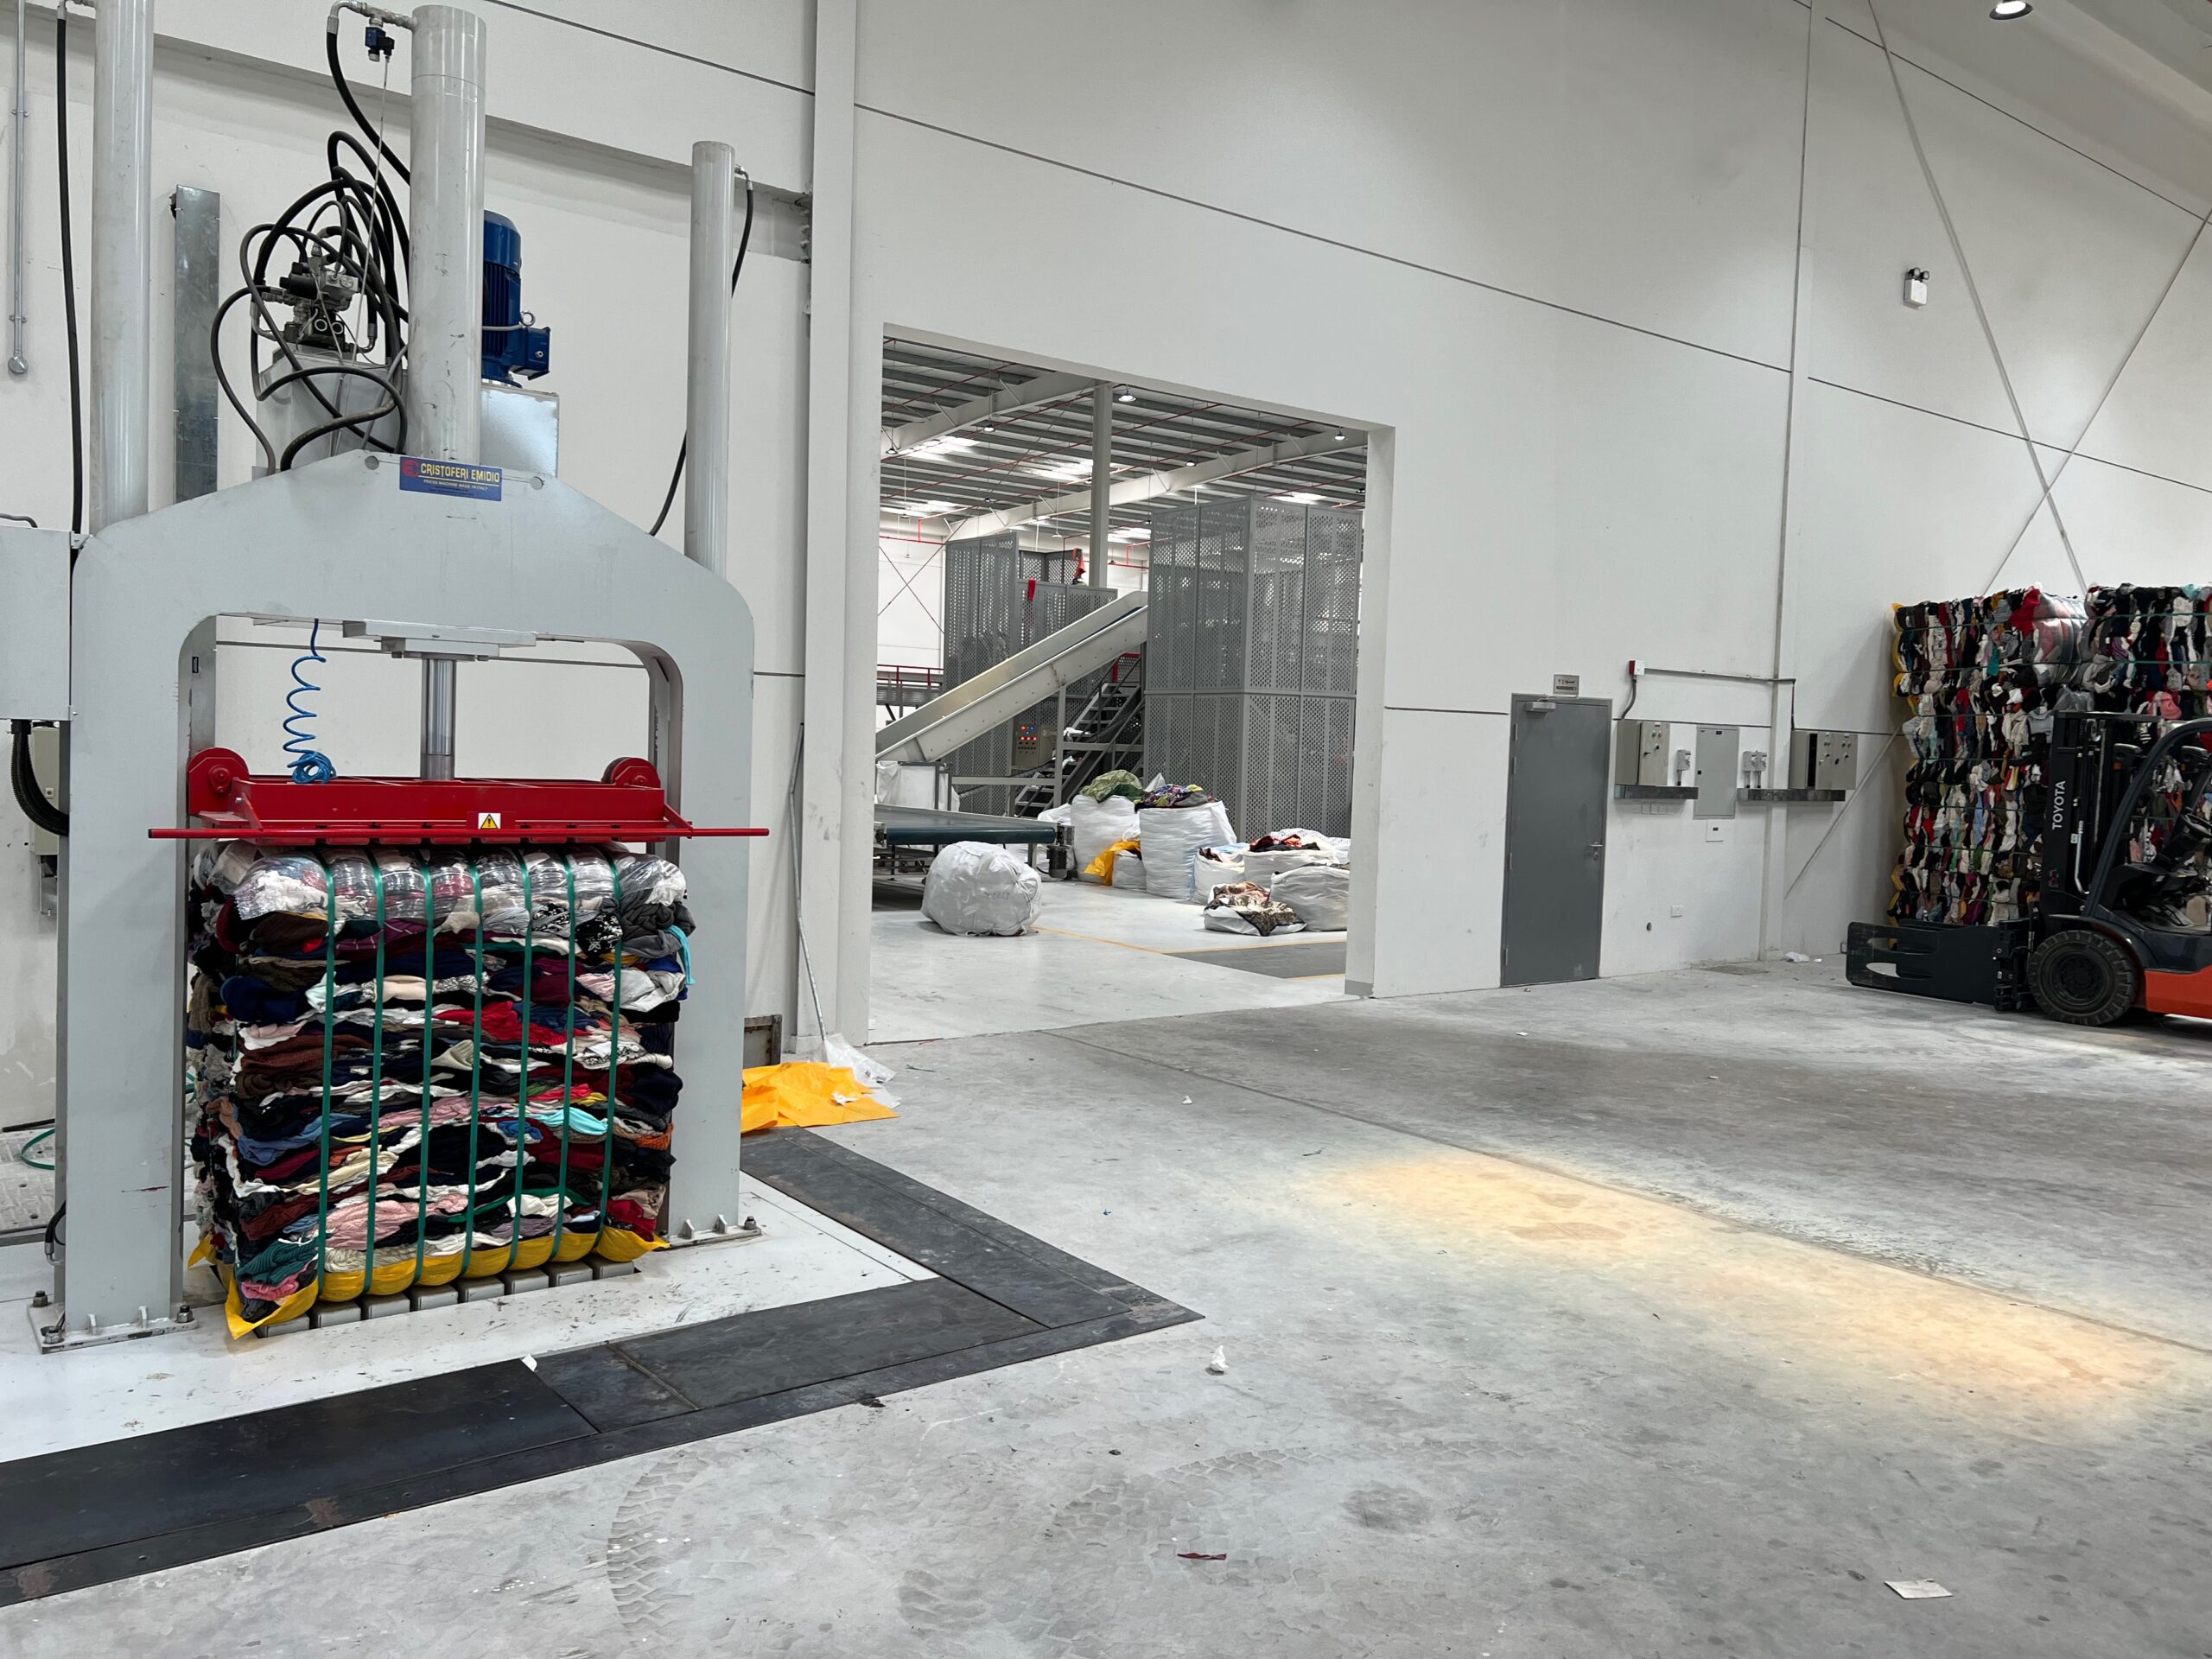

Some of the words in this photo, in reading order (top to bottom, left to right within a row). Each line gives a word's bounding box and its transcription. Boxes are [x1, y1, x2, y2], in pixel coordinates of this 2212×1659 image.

[421, 463, 468, 480] CRISTOFERI
[471, 469, 500, 482] EMIDIO
[2052, 780, 2066, 830] TOYOTA
